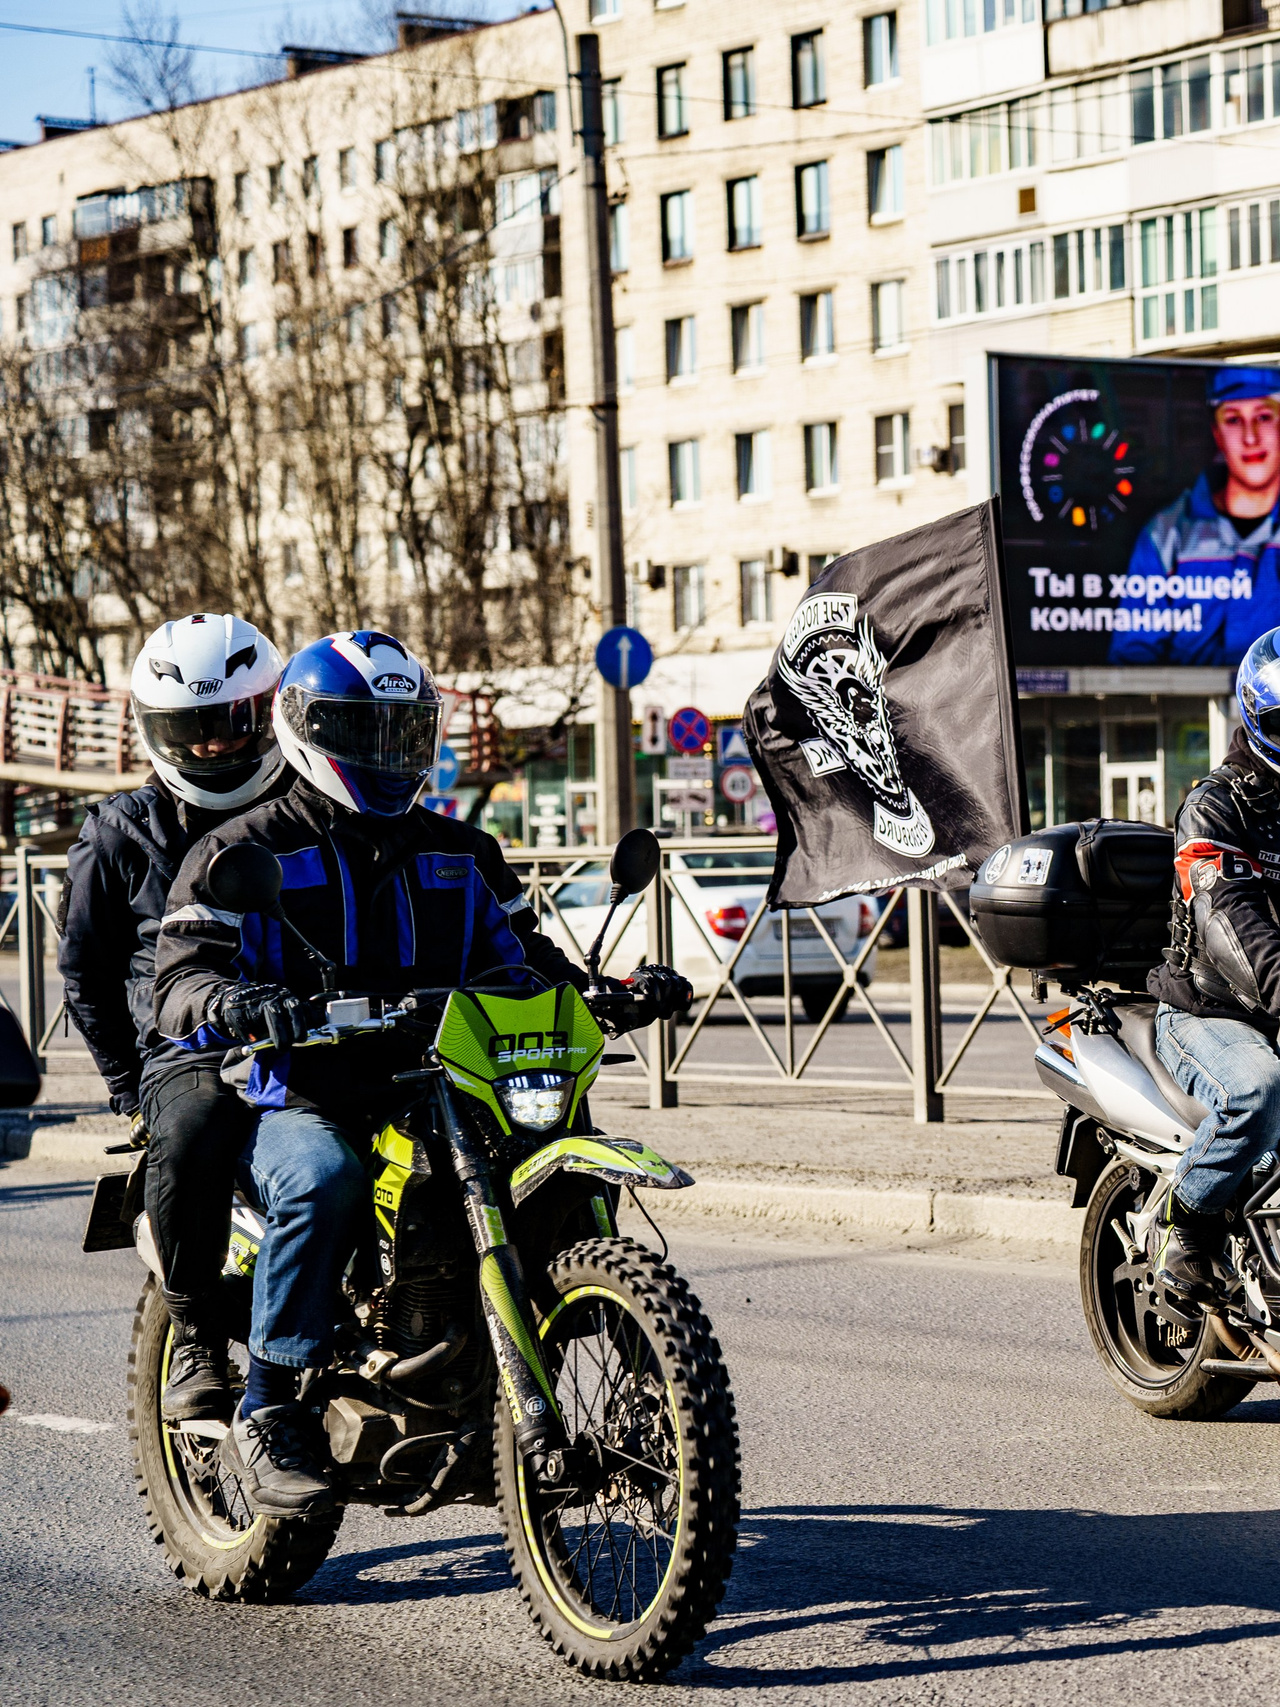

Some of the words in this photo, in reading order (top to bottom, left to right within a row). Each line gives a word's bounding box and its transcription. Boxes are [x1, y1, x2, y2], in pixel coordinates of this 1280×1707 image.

[1028, 567, 1075, 598] Ты
[1083, 573, 1103, 598] в
[1108, 568, 1252, 606] хорошей
[1030, 603, 1203, 632] компании!
[376, 675, 414, 689] Airoh
[1260, 851, 1276, 862] THE
[488, 1031, 568, 1058] 003
[497, 1047, 566, 1063] SPORT
